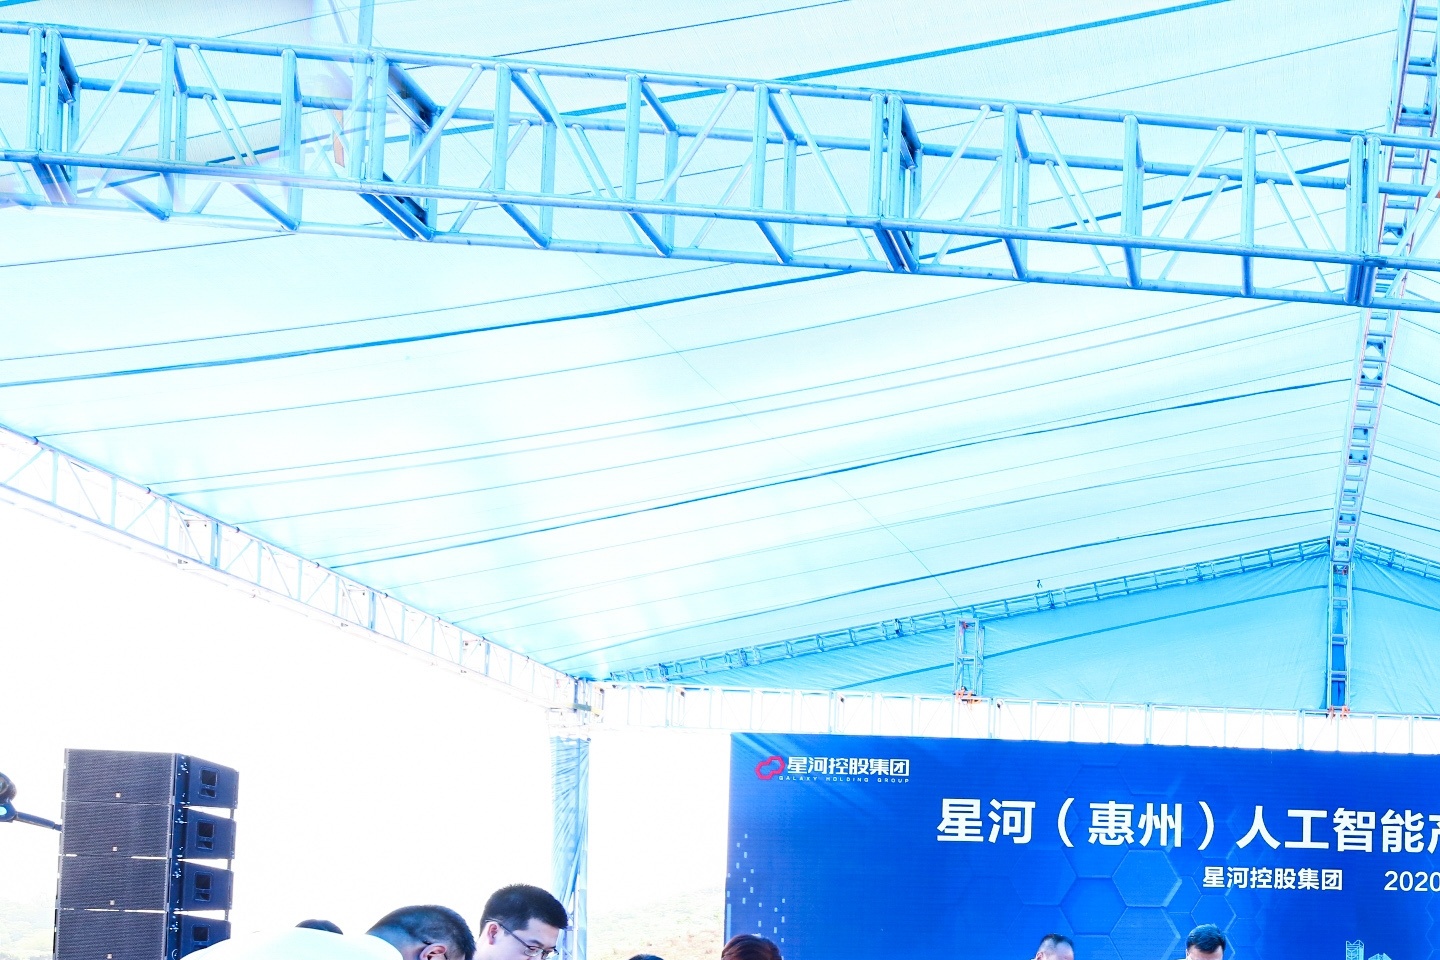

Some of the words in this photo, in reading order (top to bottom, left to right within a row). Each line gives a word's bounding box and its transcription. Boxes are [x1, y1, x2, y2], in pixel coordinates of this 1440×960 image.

[787, 756, 910, 777] 星河控股集团
[1202, 865, 1344, 891] 星河控股集团
